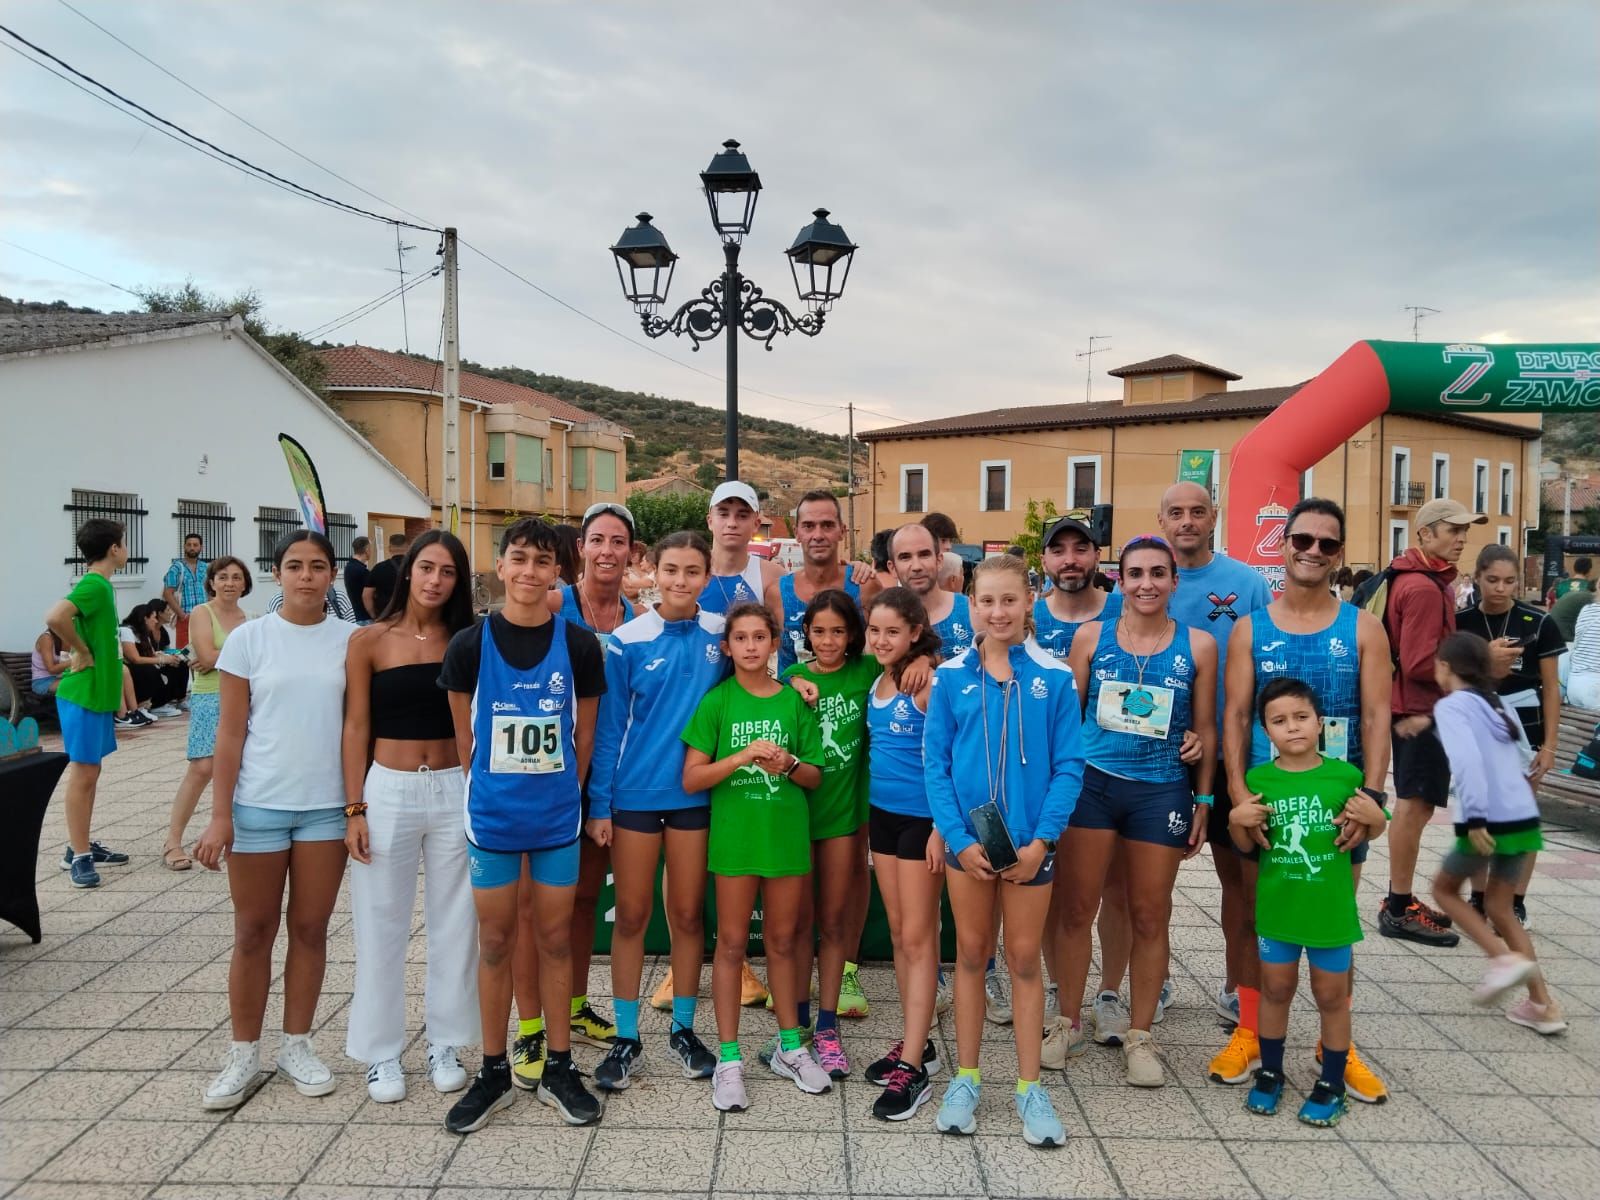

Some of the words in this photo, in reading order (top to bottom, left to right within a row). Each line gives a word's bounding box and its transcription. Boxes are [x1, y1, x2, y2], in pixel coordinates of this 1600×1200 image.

[1515, 351, 1600, 369] DIPUTAC
[1500, 380, 1600, 406] ZAMO
[827, 699, 860, 722] ERIA
[732, 720, 782, 737] RIBERA
[502, 723, 558, 755] 105
[731, 776, 765, 787] MORALES
[1266, 794, 1322, 815] RIBERA
[1270, 813, 1288, 827] DEL
[1299, 808, 1334, 826] ERIA
[1271, 856, 1305, 865] MORALES
[1310, 854, 1321, 863] DE
